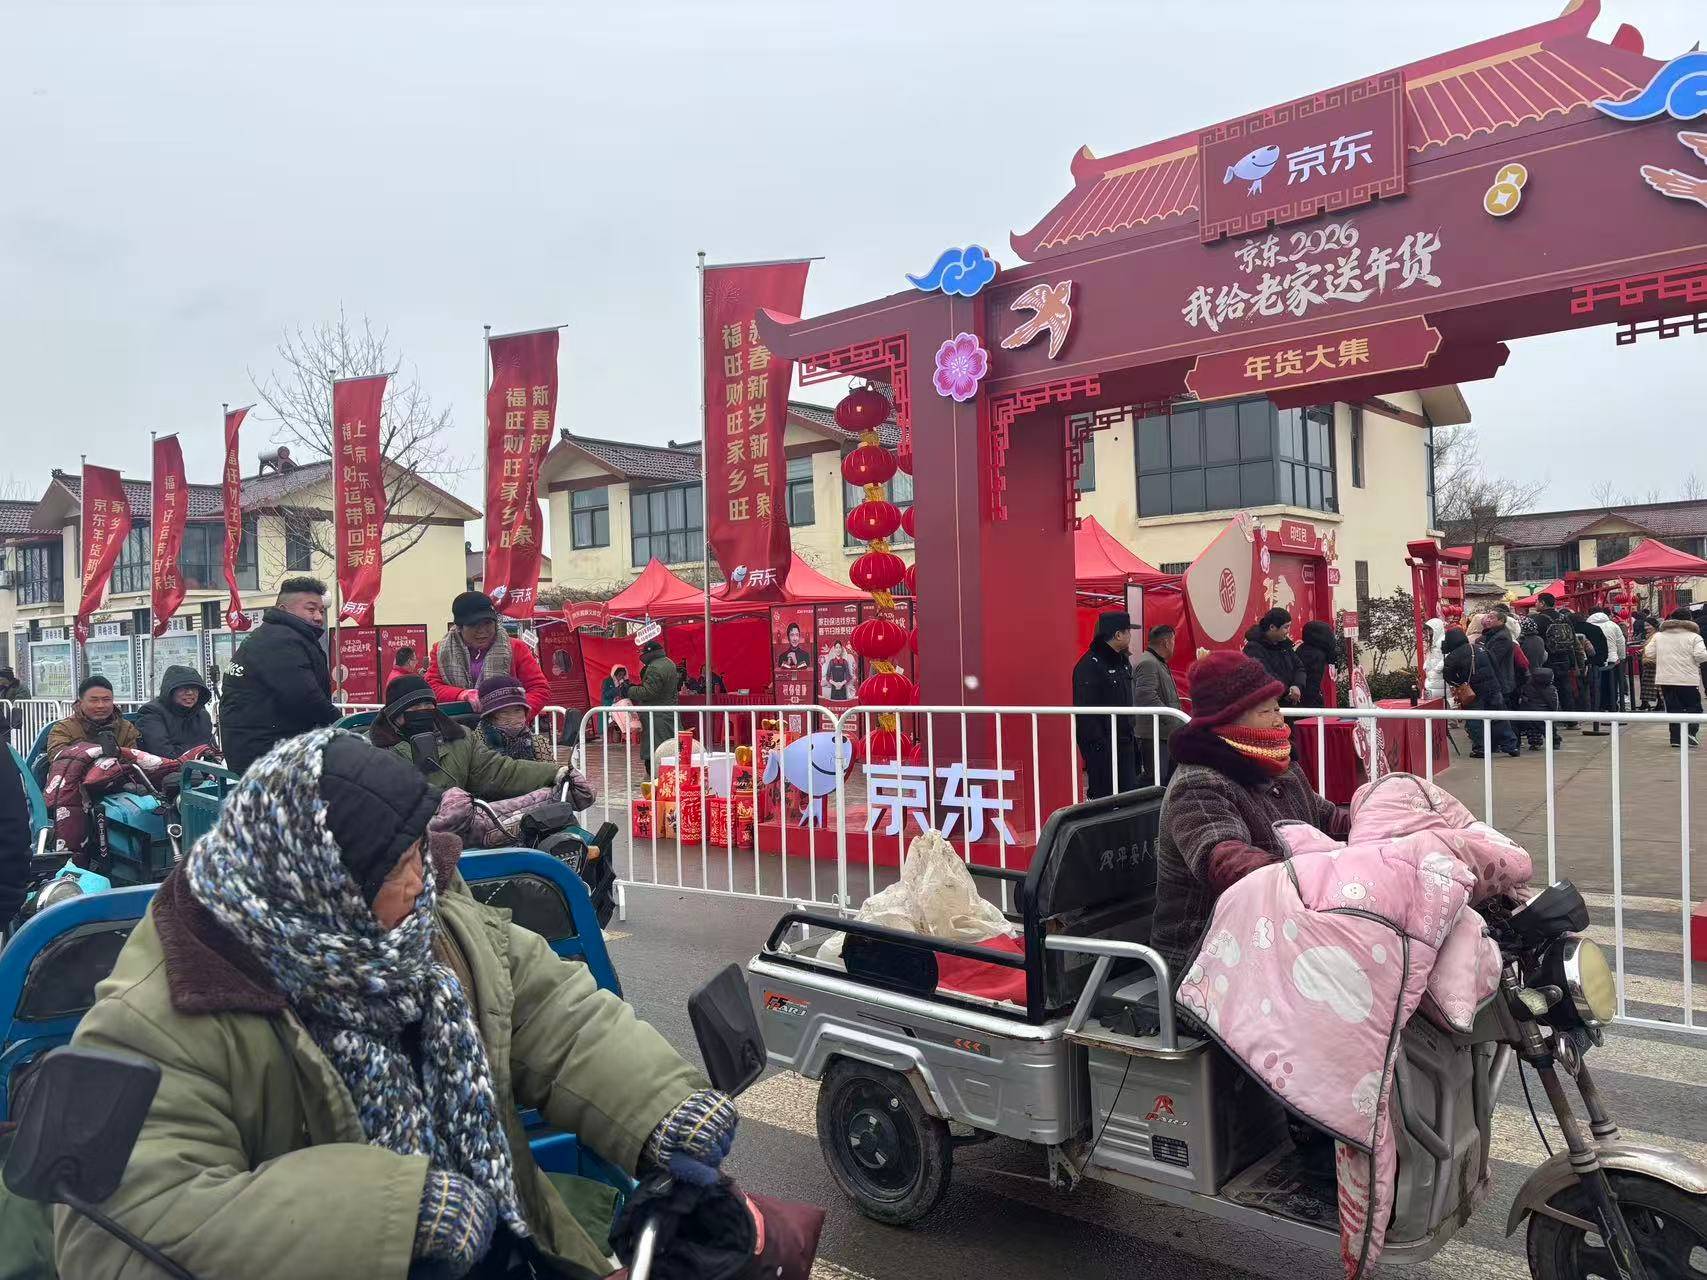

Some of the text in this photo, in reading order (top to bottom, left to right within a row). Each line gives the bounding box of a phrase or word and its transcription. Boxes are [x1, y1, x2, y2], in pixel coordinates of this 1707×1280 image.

[1286, 130, 1373, 185] 京东
[1181, 224, 1442, 333] 我给老家送年货
[1243, 337, 1370, 381] 年货大集
[721, 321, 750, 521] 福旺财旺家乡旺
[509, 587, 532, 603] 京东
[746, 567, 778, 588] 京东
[862, 760, 1016, 846] 京东
